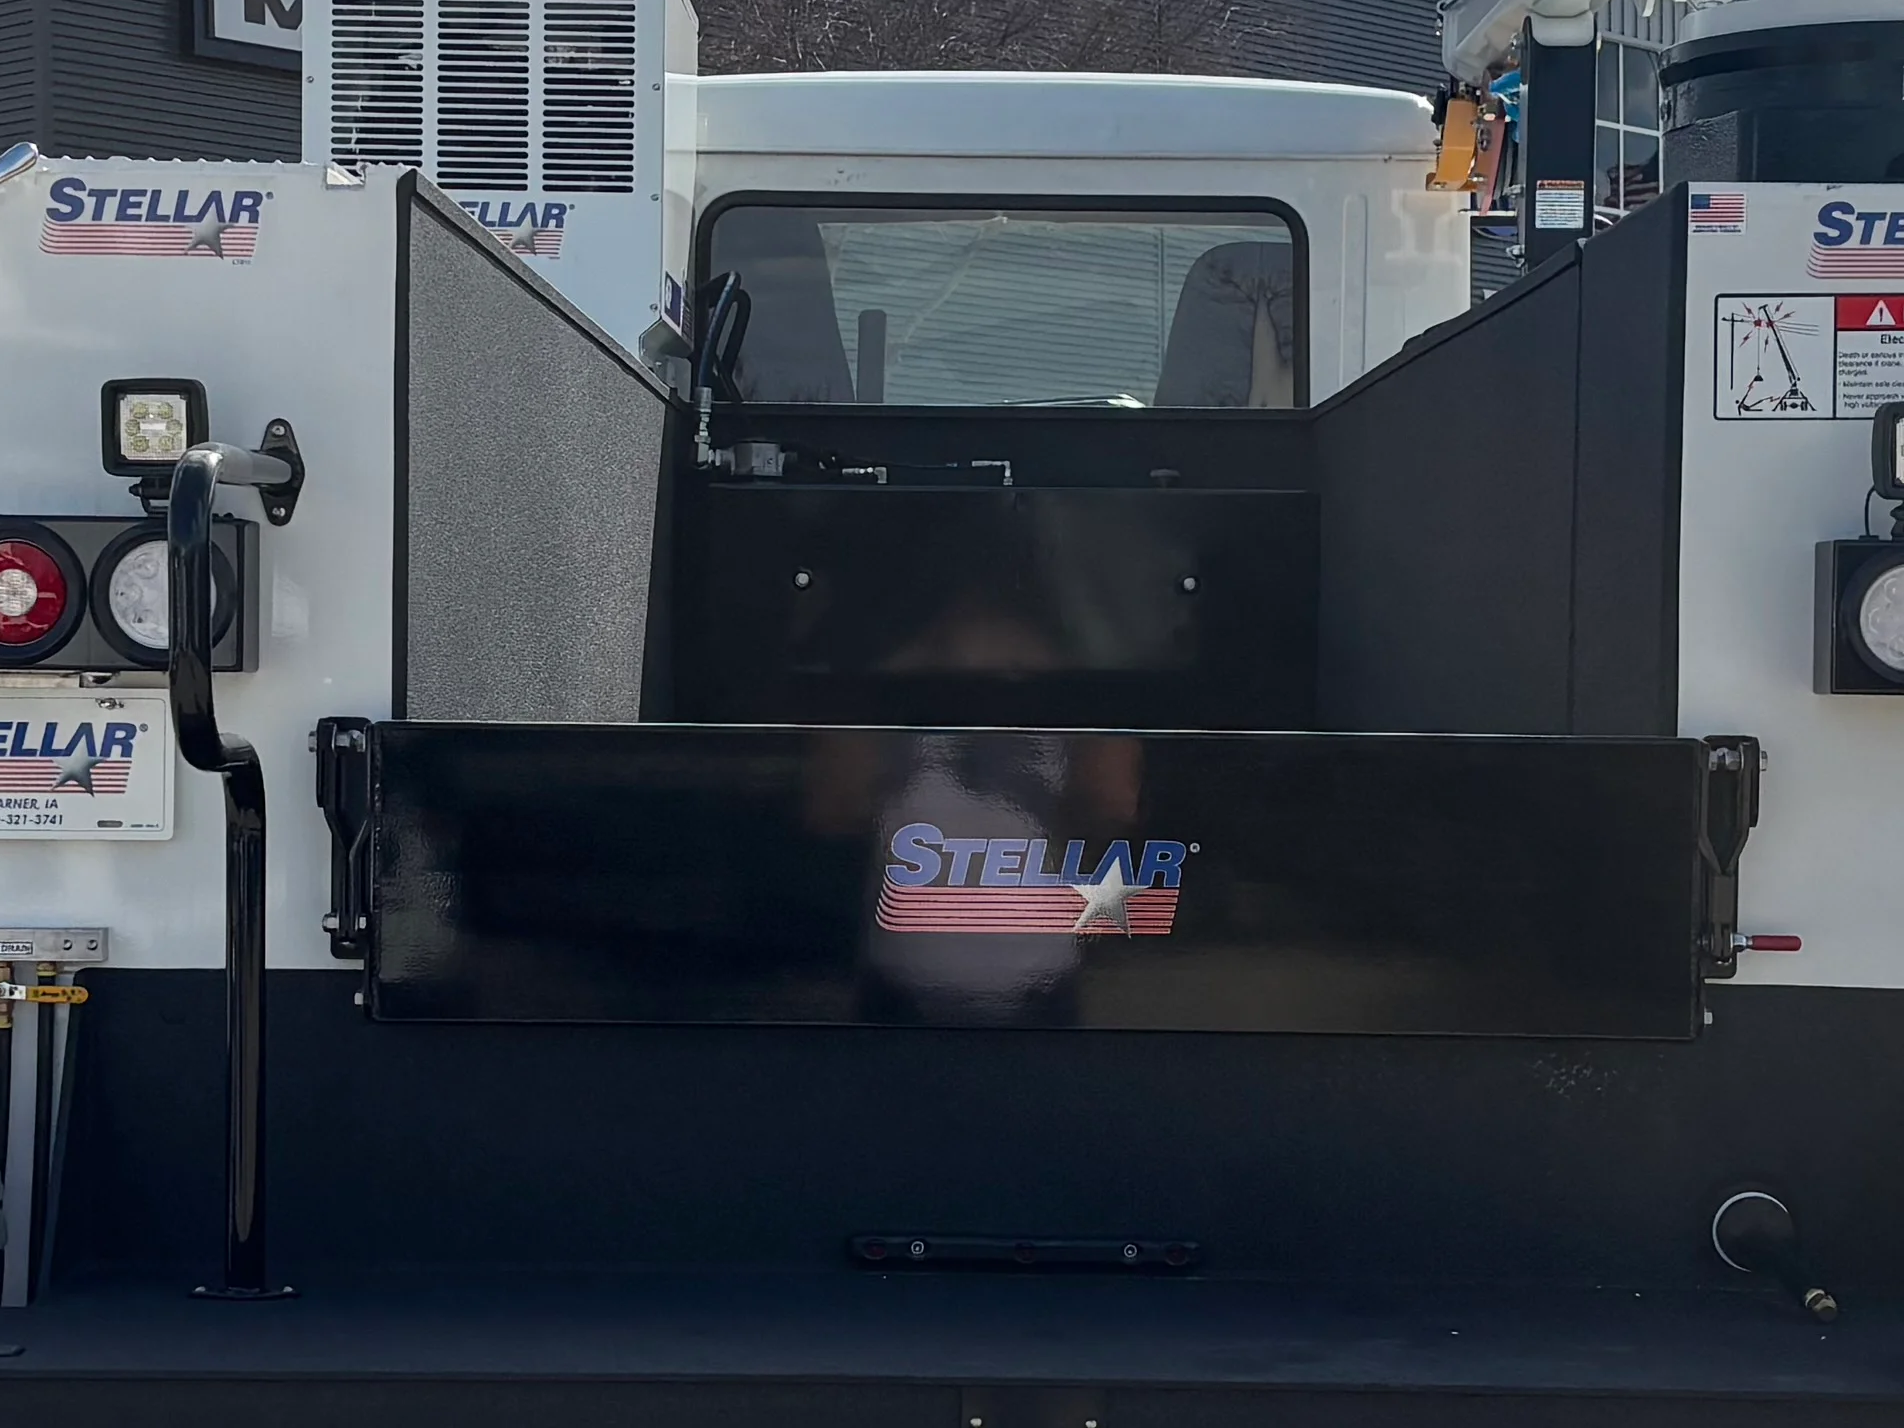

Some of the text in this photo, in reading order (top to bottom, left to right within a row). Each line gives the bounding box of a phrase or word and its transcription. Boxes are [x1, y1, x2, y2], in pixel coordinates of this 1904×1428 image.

[45, 176, 264, 224] STELLAR
[44, 798, 59, 809] IA
[885, 822, 1187, 888] STELLAR
